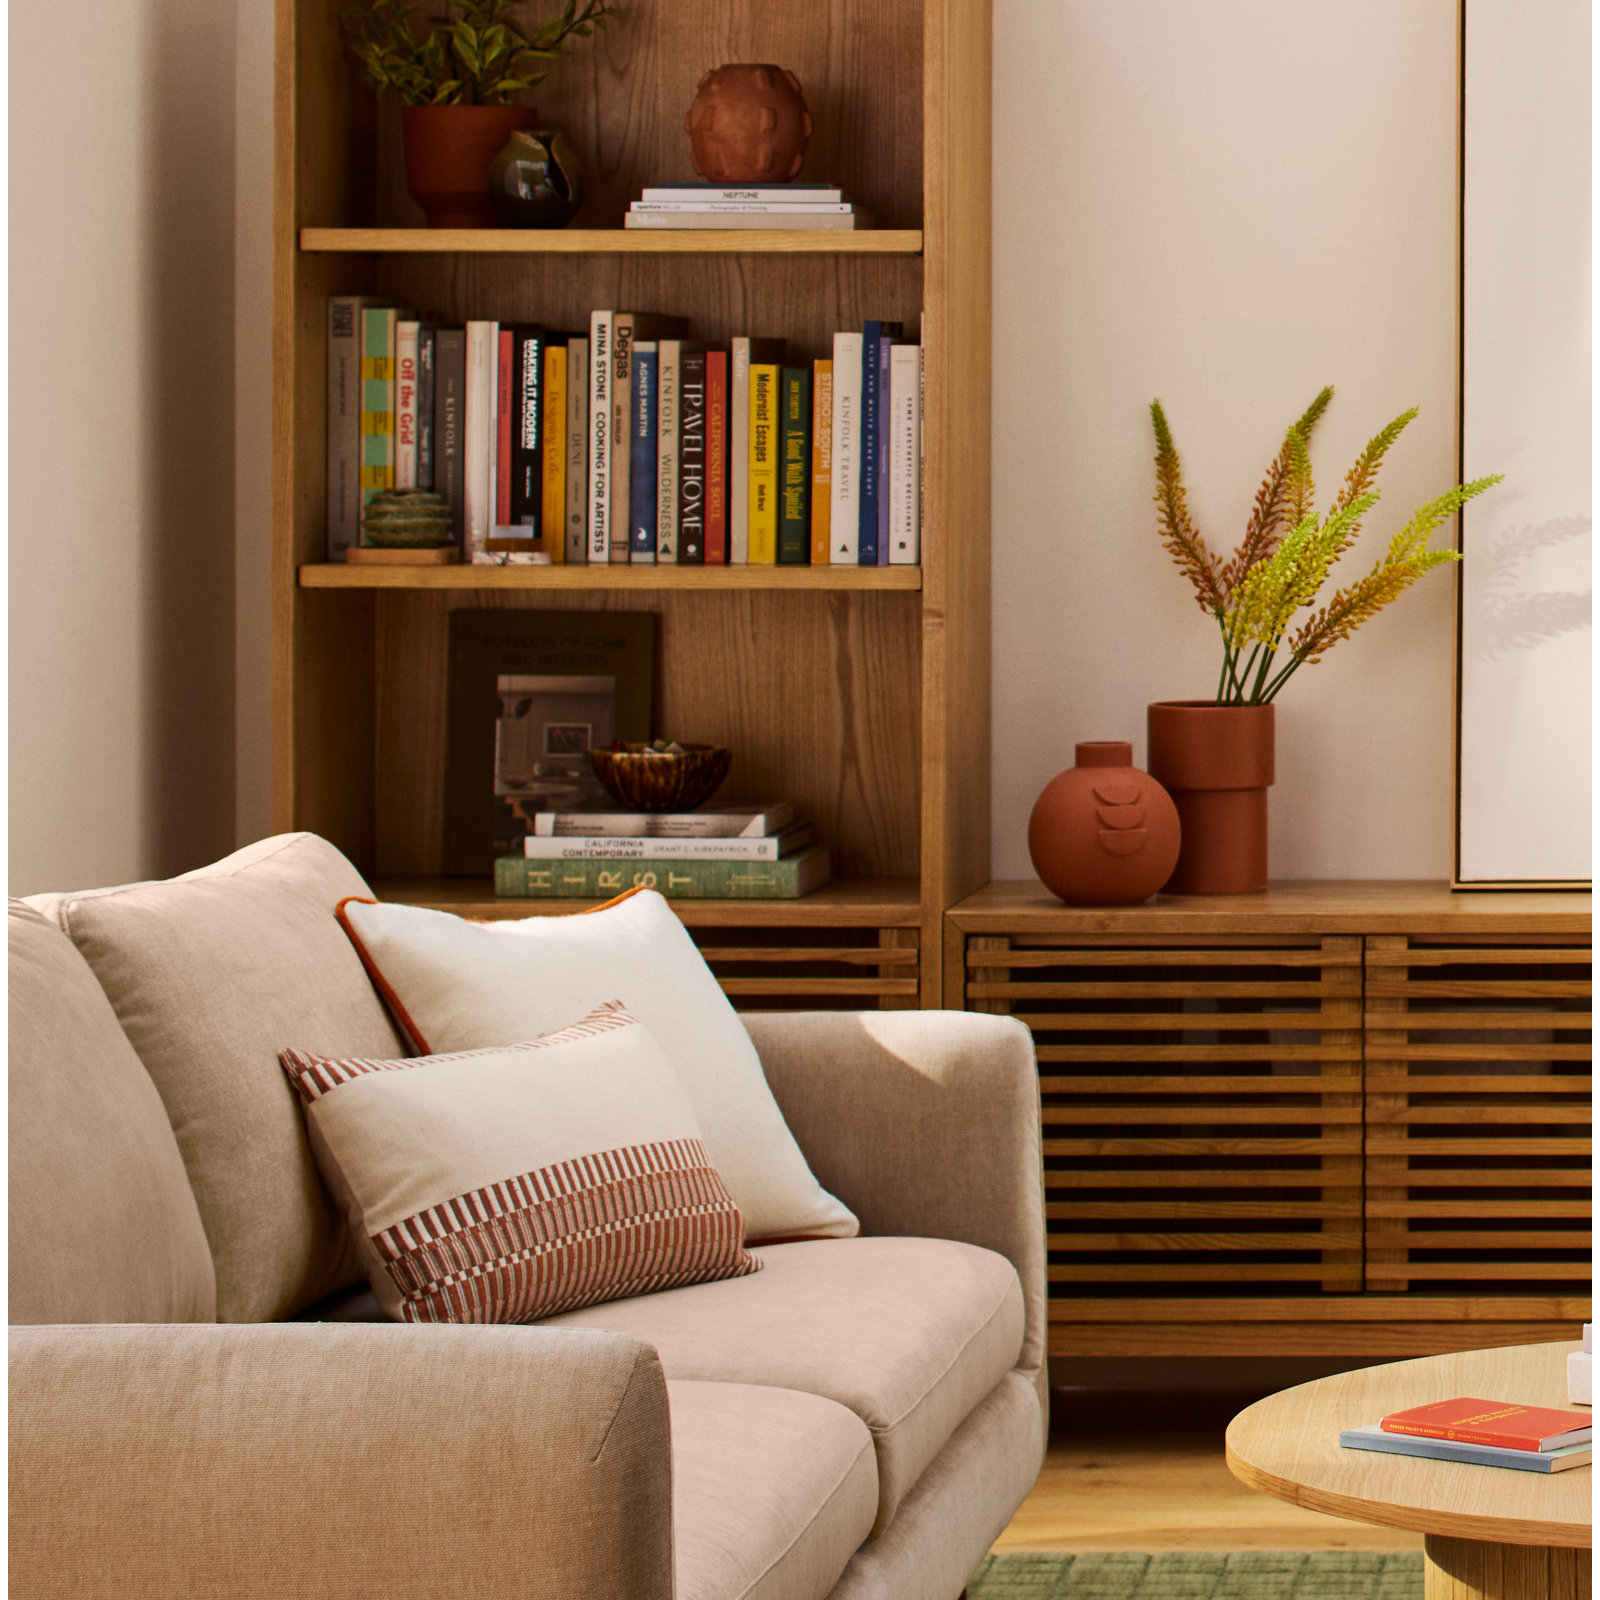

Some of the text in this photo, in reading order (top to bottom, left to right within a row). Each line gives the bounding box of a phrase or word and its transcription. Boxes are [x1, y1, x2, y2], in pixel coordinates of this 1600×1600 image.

[401, 358, 414, 380] Off
[614, 326, 632, 379] Degas
[401, 386, 414, 408] the
[526, 340, 538, 449] MAKING IT MODERN
[639, 362, 648, 437] AGNES MARTIN
[822, 372, 832, 417] STUDIO
[400, 413, 414, 445] Grid
[446, 398, 454, 456] KINFOLK
[546, 391, 561, 445] Designing
[594, 324, 606, 552] MINA STONE COOKING FOR ARTISTS
[682, 380, 703, 458] TRAVEL
[754, 374, 770, 462] Modernist Escapes
[571, 433, 582, 466] DUNE
[660, 366, 673, 538] KINFOLK WILDERNESS
[711, 403, 722, 482] CALIFORNIA
[786, 439, 804, 460] Good
[820, 428, 831, 469] SOUTH
[840, 396, 851, 500] KINFOLK TRAVEL
[547, 447, 559, 485] Coffee
[786, 462, 804, 484] Walk
[682, 464, 702, 534] HOME
[710, 486, 720, 522] SOUL
[783, 486, 804, 520] Spoiled
[584, 637, 626, 650] HOME
[562, 848, 644, 858] CONTEMPORARY
[584, 840, 643, 848] CALIFORNIA
[528, 872, 692, 888] HIRST
